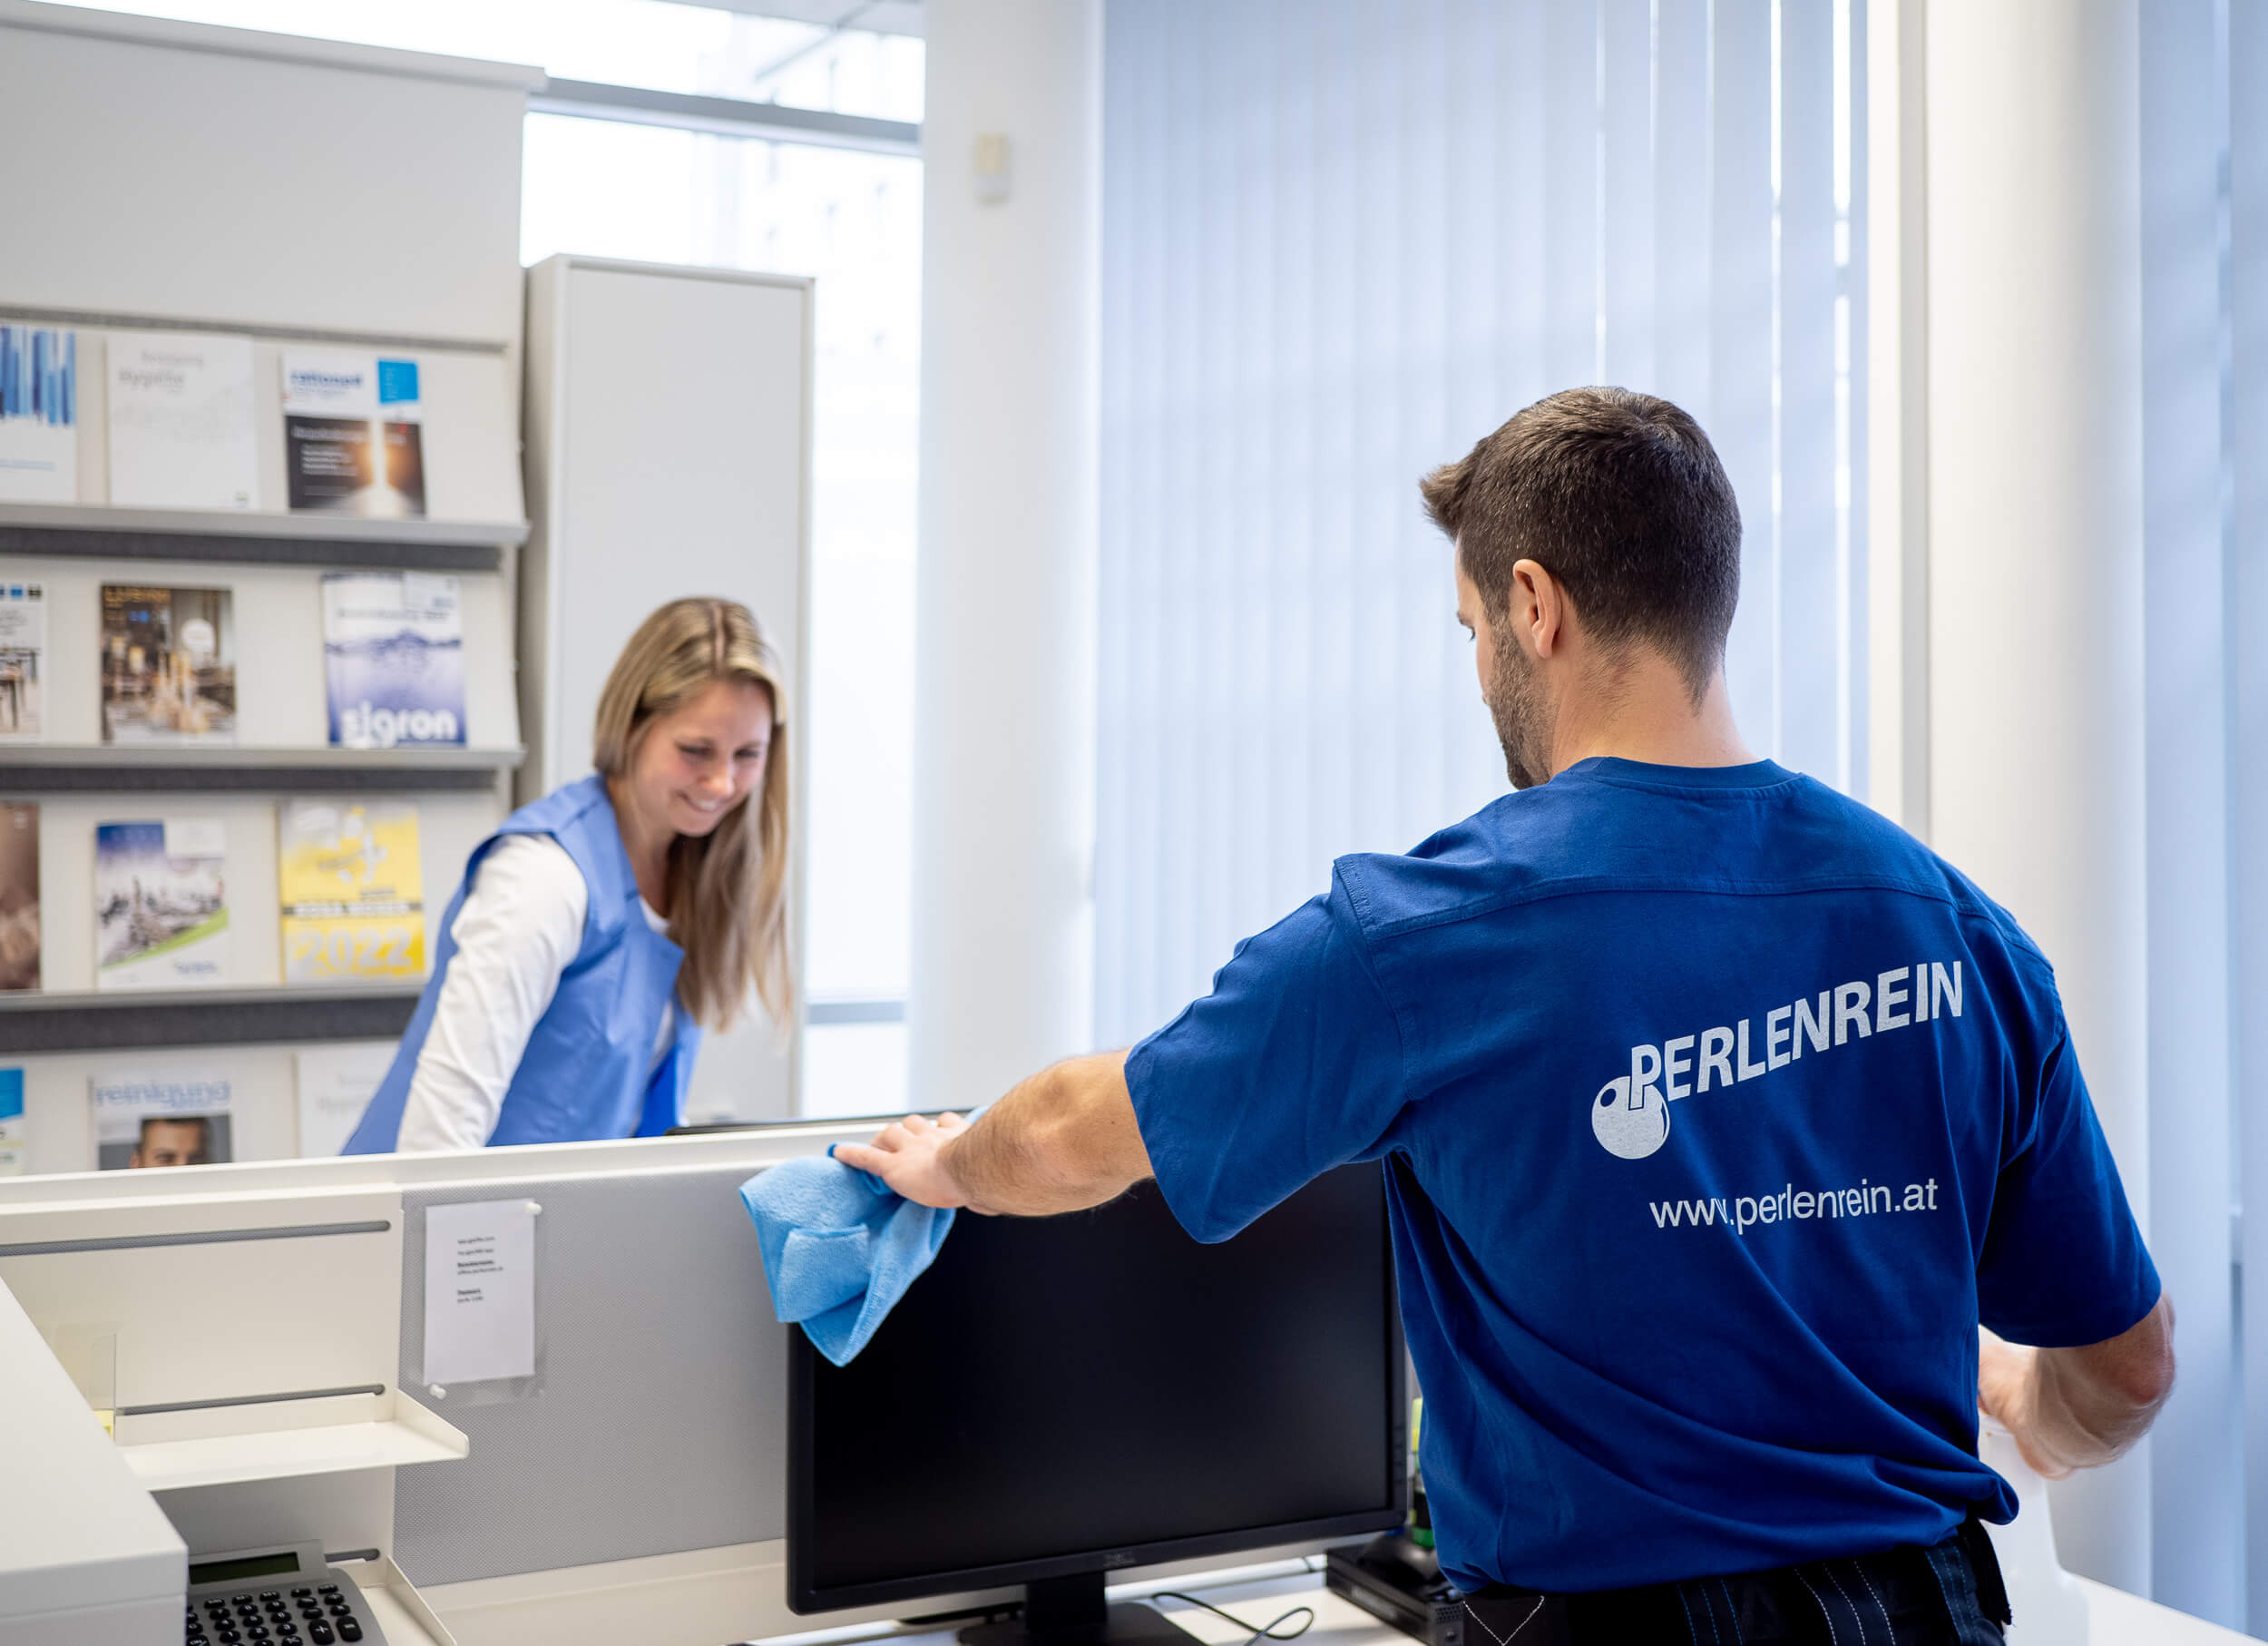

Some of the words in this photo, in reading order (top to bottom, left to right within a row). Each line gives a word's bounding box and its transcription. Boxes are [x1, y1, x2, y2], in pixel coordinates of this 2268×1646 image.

[293, 926, 413, 973] 2022
[1628, 960, 1963, 1109] PERLENREIN
[1649, 1178, 1939, 1235] www.perlenrein.at
